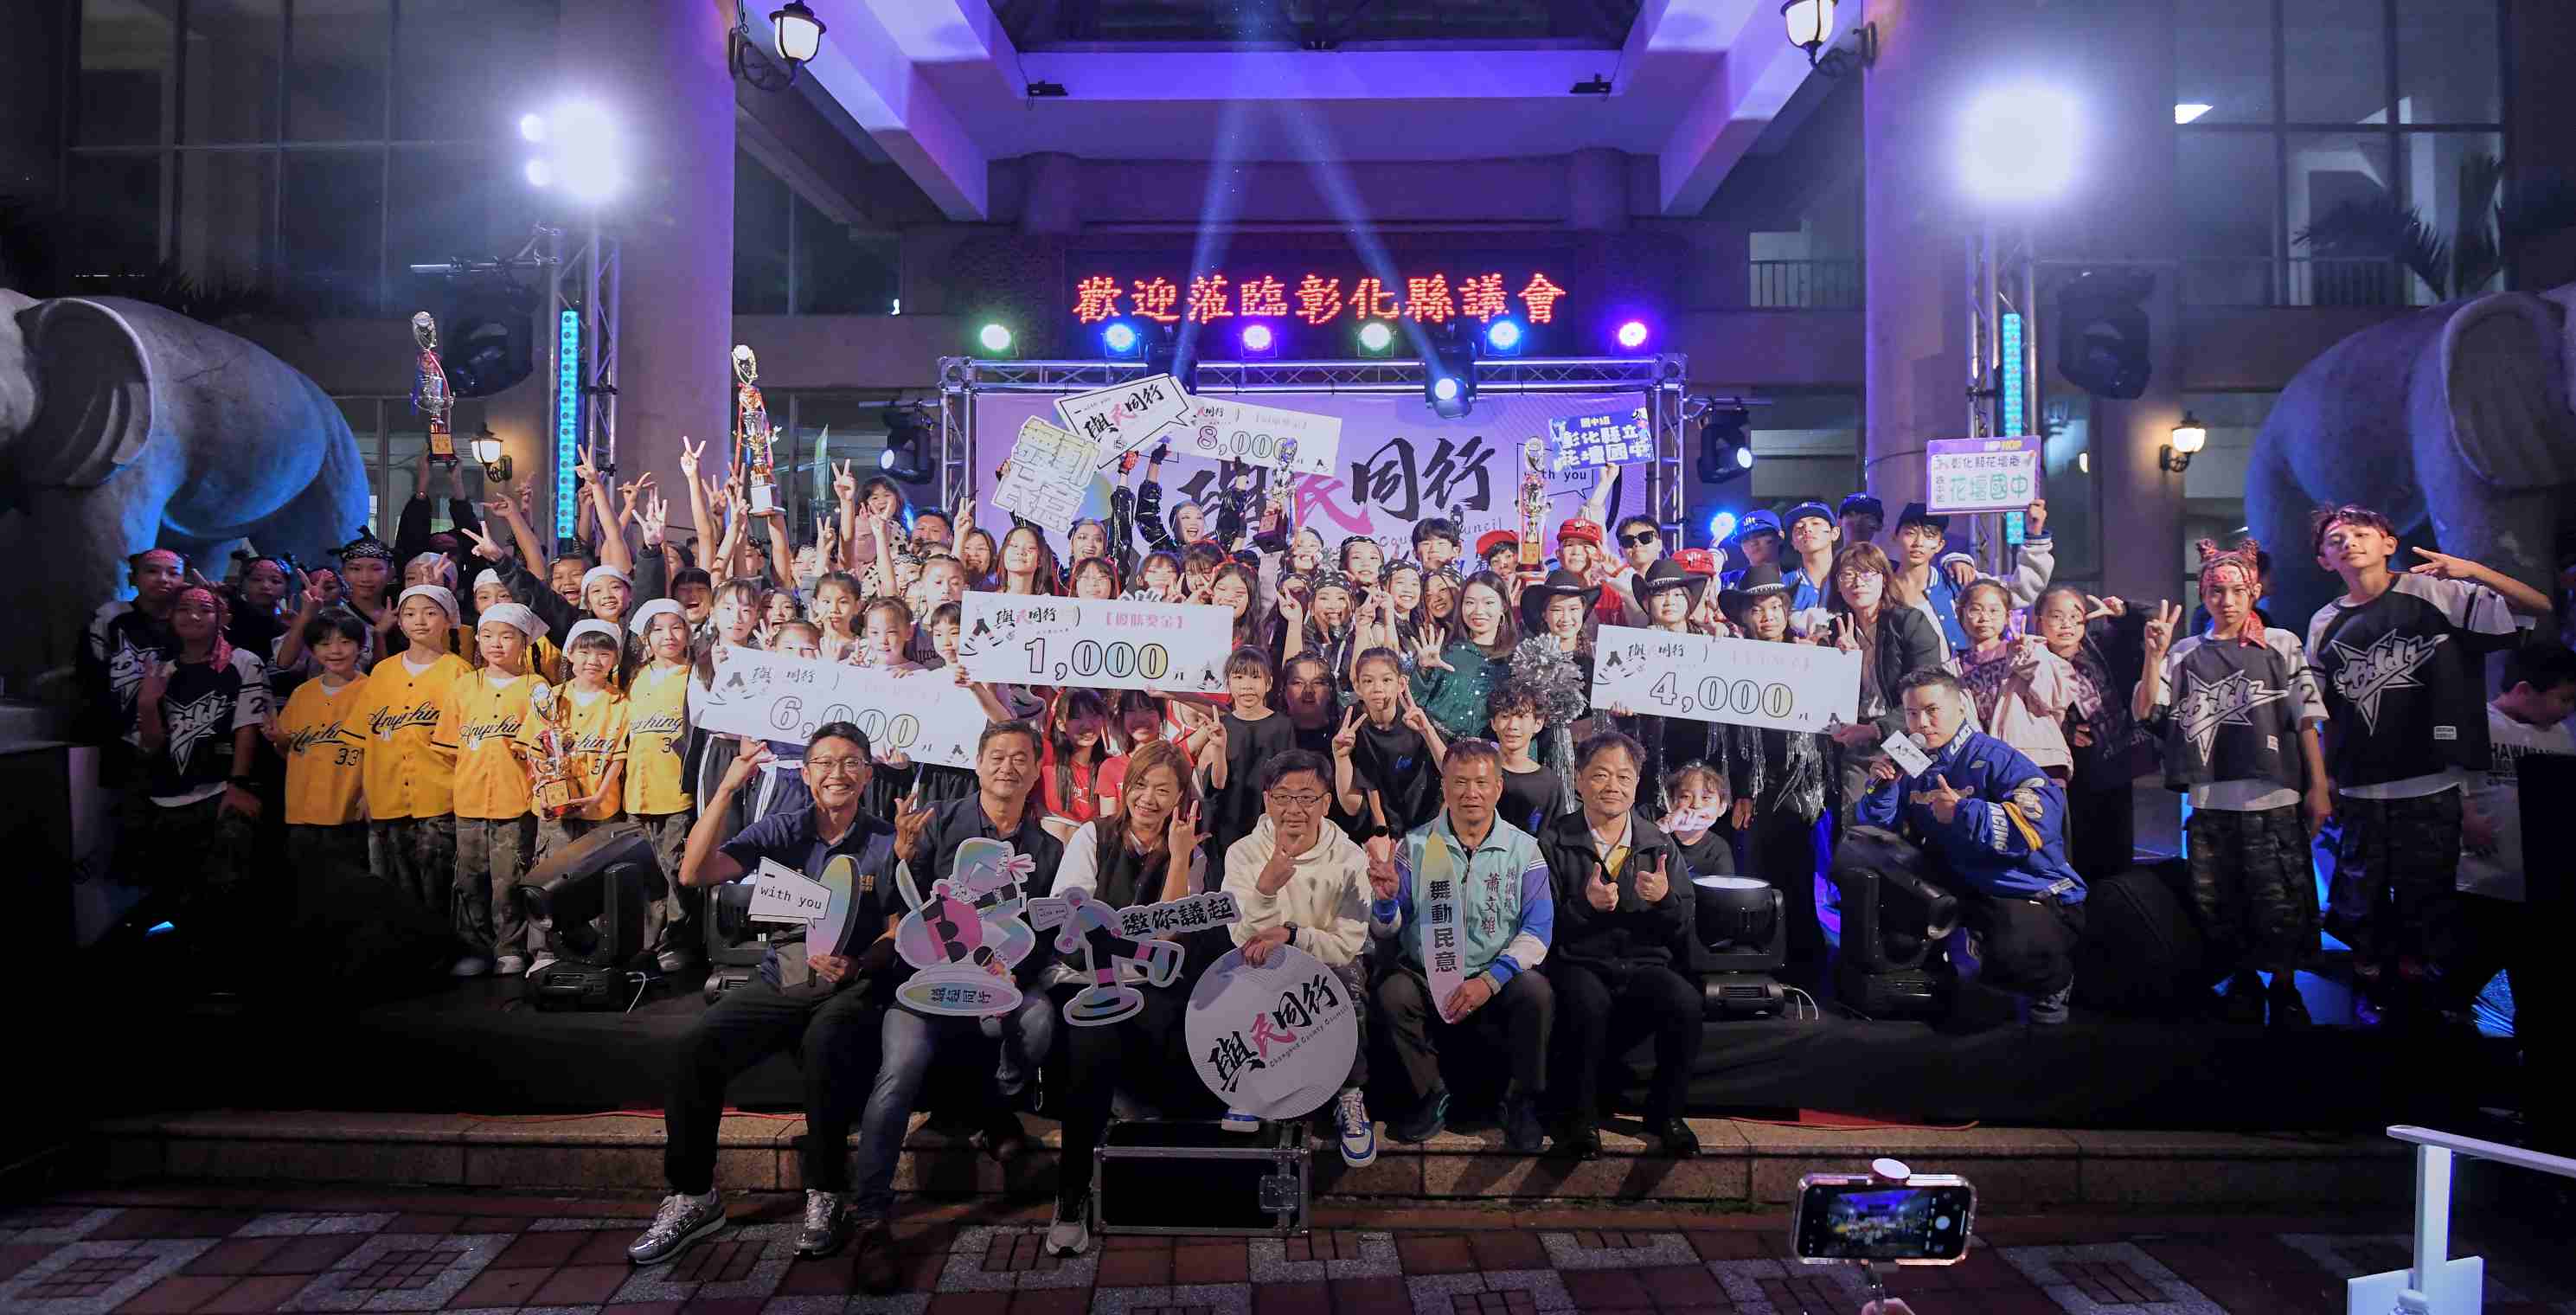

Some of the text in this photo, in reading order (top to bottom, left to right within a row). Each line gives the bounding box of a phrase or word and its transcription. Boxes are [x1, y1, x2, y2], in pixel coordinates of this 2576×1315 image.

[1073, 273, 1567, 324] 歡迎蒞臨彰化縣議會
[1563, 471, 1587, 483] you
[1951, 473, 2028, 502] 花壇國中
[996, 606, 1057, 629] 與民同行
[1024, 638, 1168, 681] 1,000
[1650, 671, 1793, 718] 4,000
[334, 747, 360, 767] 33
[759, 884, 823, 910] with you
[1122, 897, 1235, 936] 邀你議起
[1429, 880, 1458, 973] 舞動民意
[1208, 974, 1339, 1093] 與民同行
